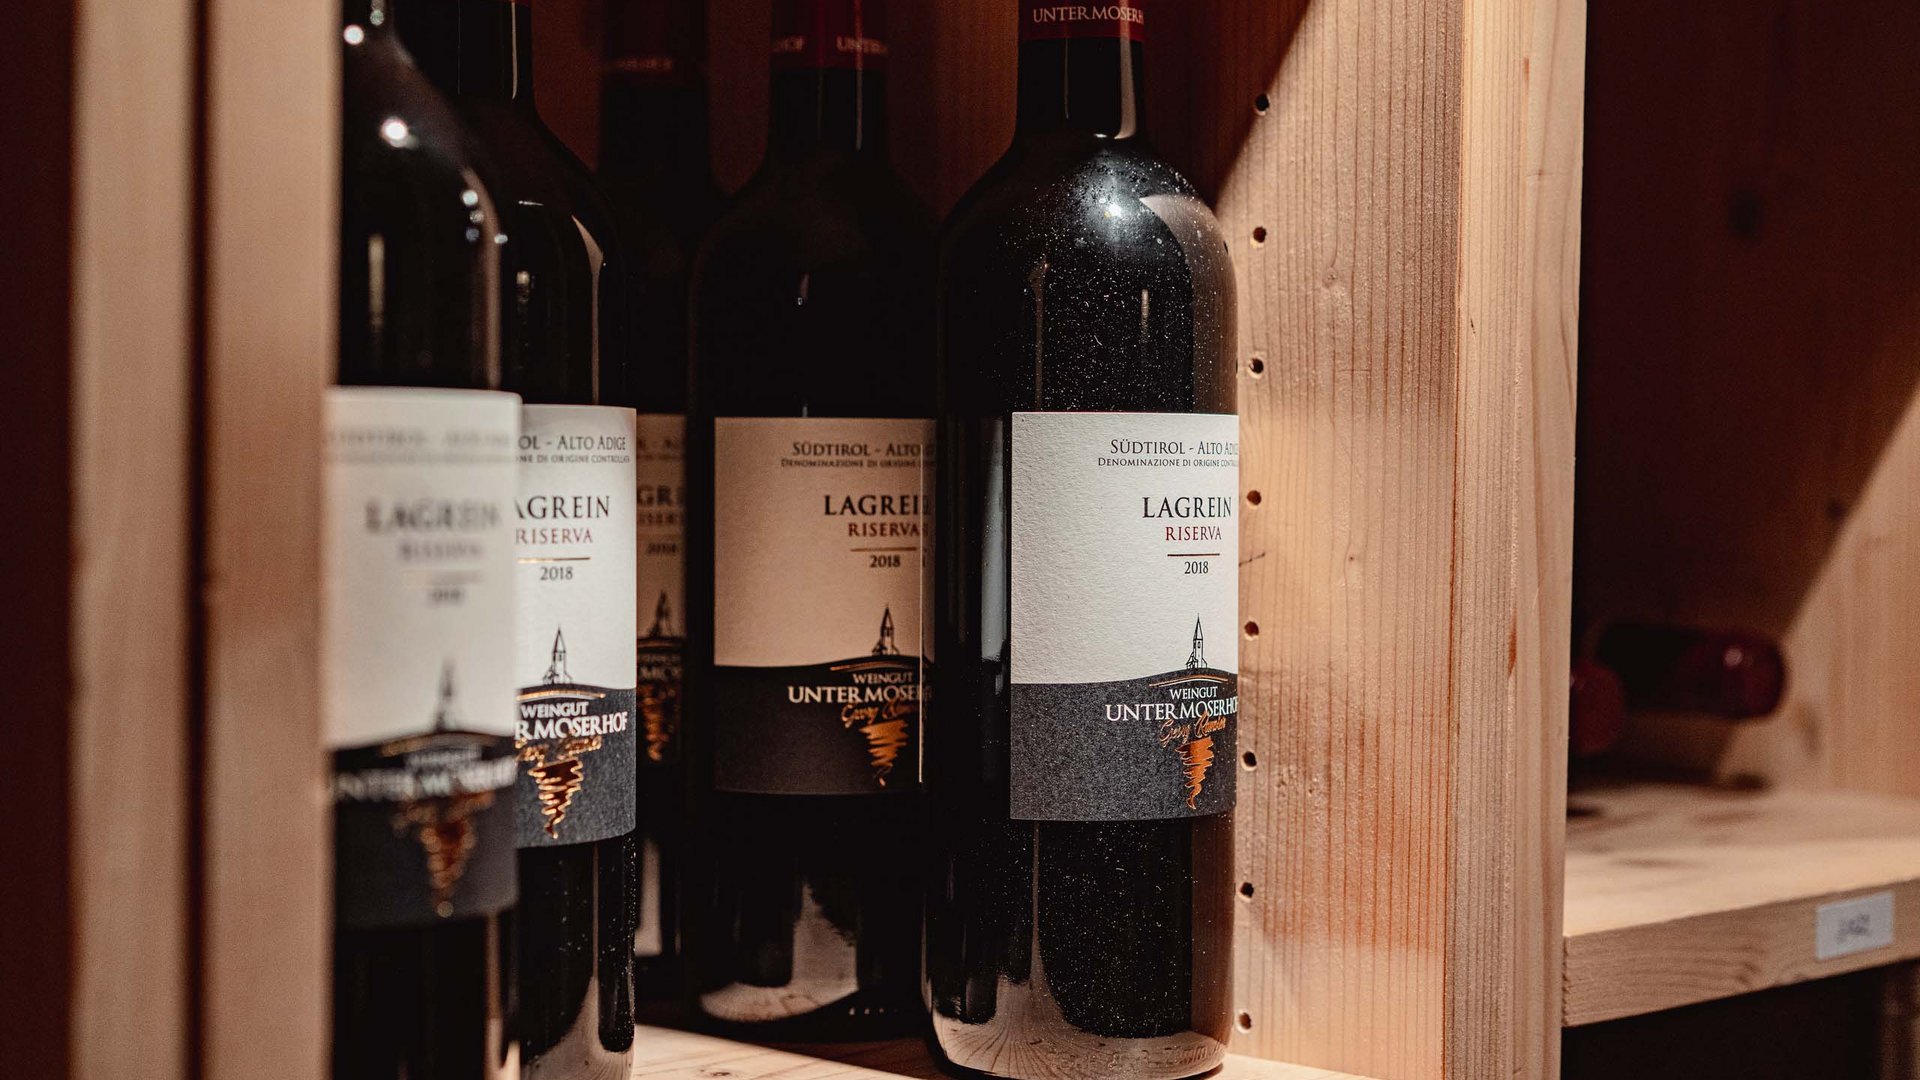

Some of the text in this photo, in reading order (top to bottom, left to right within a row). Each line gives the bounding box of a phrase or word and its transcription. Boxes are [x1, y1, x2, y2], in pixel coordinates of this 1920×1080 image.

[517, 434, 541, 451] OL
[556, 434, 595, 451] ALTO
[597, 434, 627, 452] ADIGE
[792, 441, 871, 457] SÜDTIROL
[885, 443, 922, 456] ALTO
[1110, 438, 1185, 455] SÜDTIROL
[1197, 440, 1223, 455] ALTO
[1097, 457, 1180, 468] DENOMINAZIONE
[1182, 458, 1192, 468] DI
[1193, 458, 1220, 468] ORIGINE
[824, 494, 922, 516] LAGREI
[1142, 496, 1232, 519] LAGREIN
[515, 528, 593, 544] RISERVA
[848, 522, 922, 538] RISERVA
[1165, 525, 1222, 541] RISERVA
[868, 554, 901, 569] 2018
[1184, 560, 1210, 575] 2018
[539, 566, 574, 581] 2018
[852, 671, 913, 685] WEINGUT
[1169, 685, 1219, 700] WEINGUT
[519, 701, 589, 719] WEINGUT
[514, 711, 629, 740] RMOSERHOF
